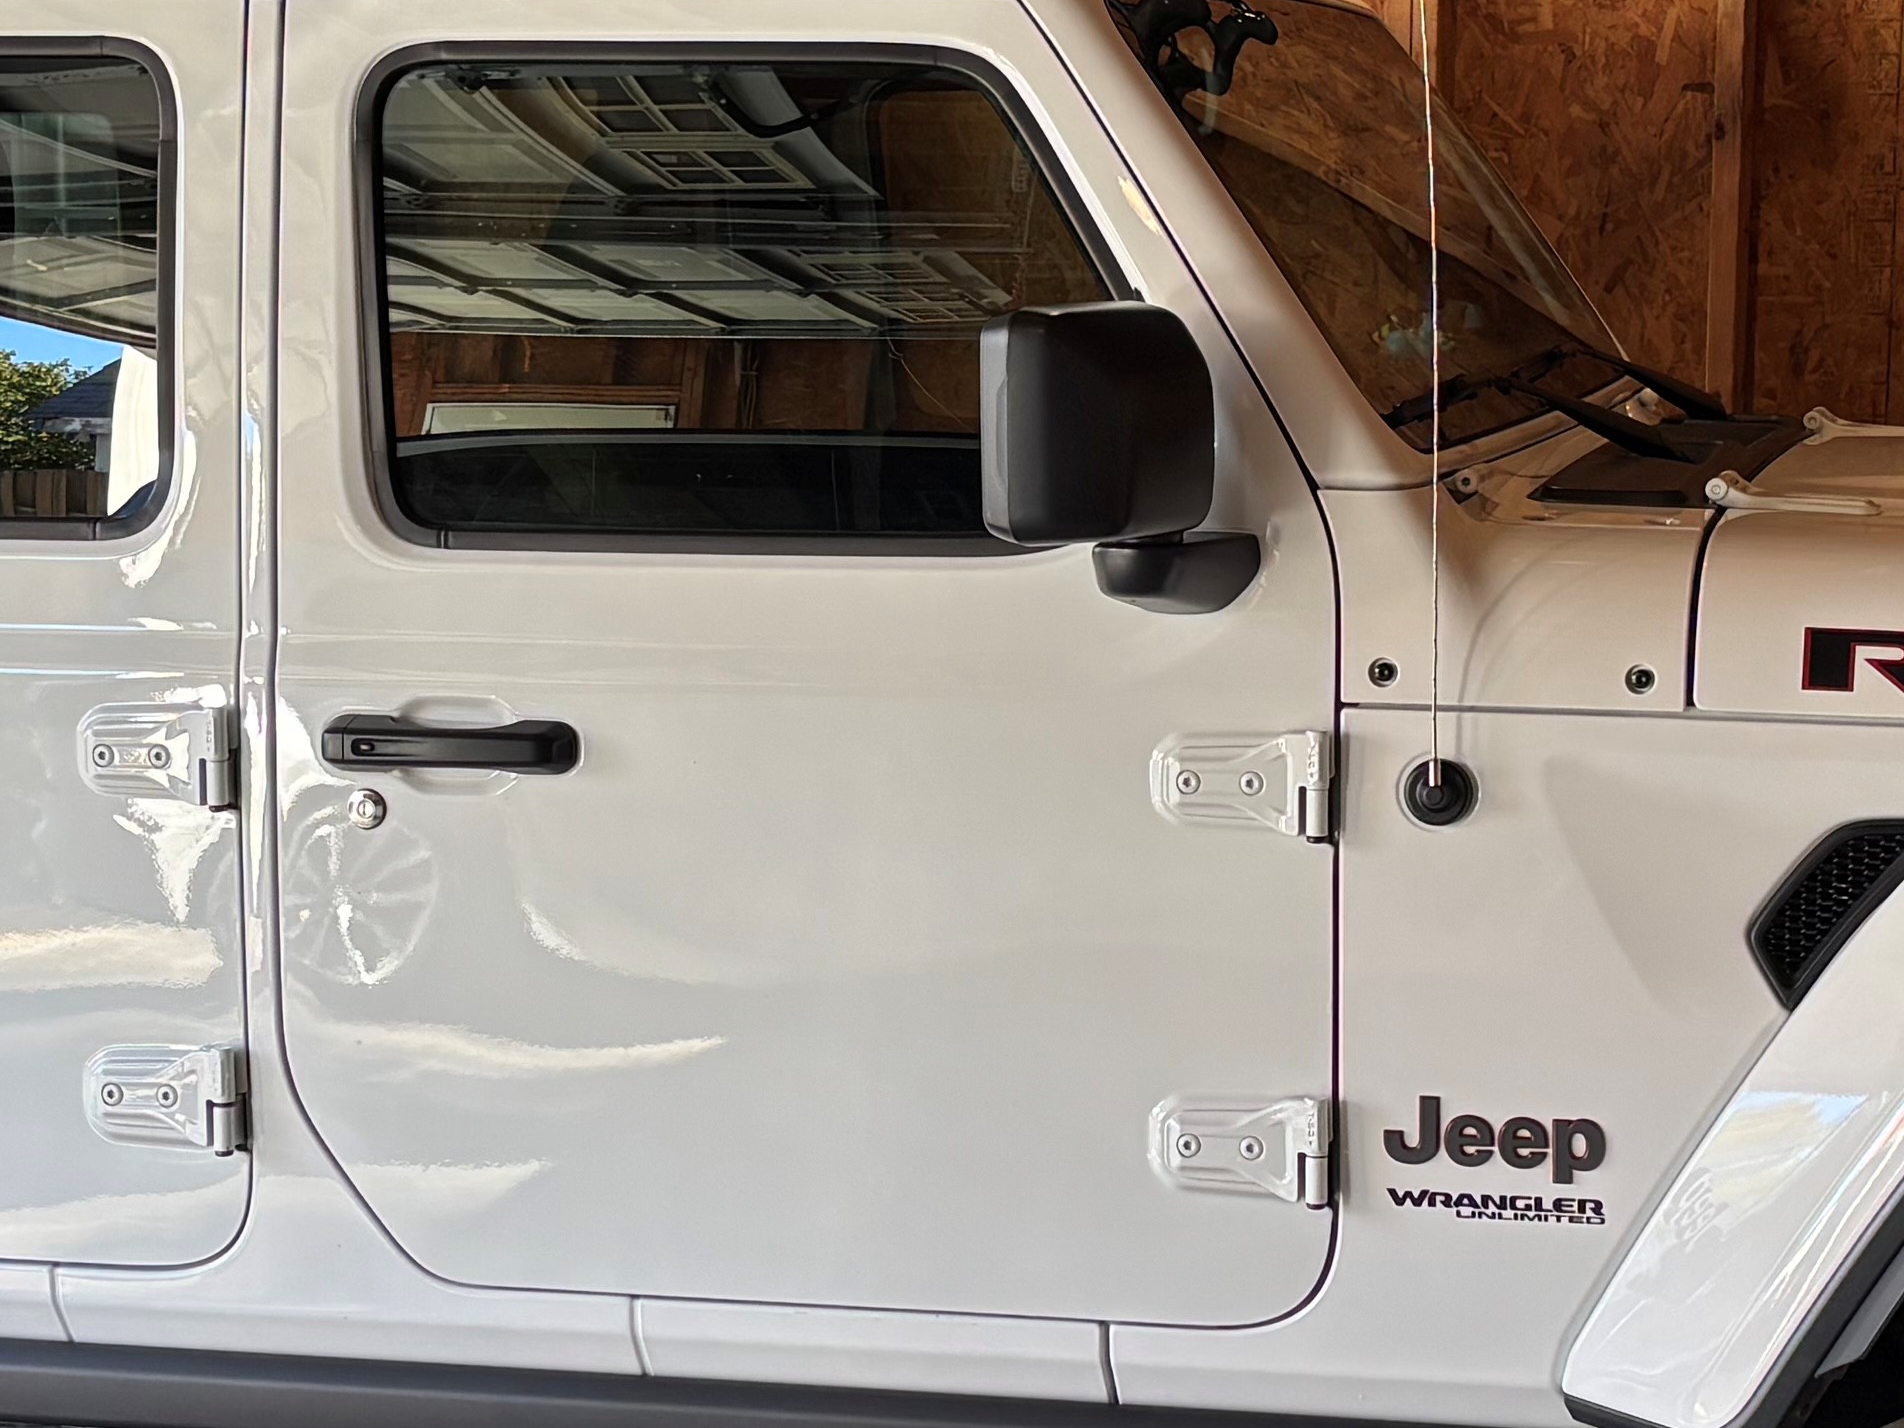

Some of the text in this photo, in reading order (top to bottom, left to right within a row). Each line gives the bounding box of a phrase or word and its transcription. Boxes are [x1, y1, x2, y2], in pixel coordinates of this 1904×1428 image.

[1382, 1094, 1608, 1185] Jeep
[1386, 1187, 1606, 1217] WRANGLER
[1455, 1208, 1606, 1226] UNLIMITED
